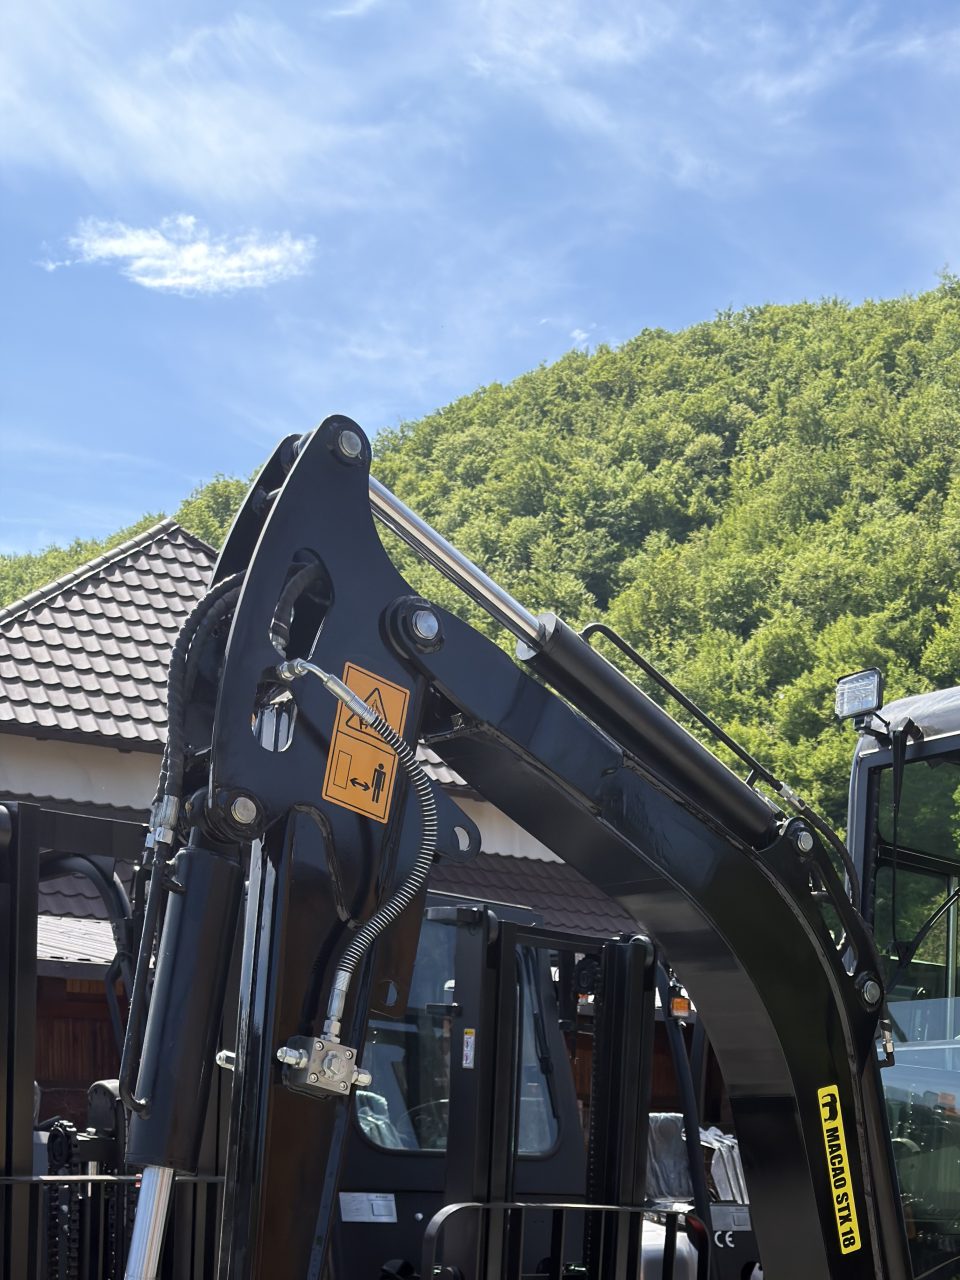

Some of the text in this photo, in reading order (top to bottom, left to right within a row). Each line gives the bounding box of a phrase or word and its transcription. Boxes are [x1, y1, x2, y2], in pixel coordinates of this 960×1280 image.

[825, 1126, 856, 1249] MACAO STX 18
[714, 1231, 735, 1248] CE
